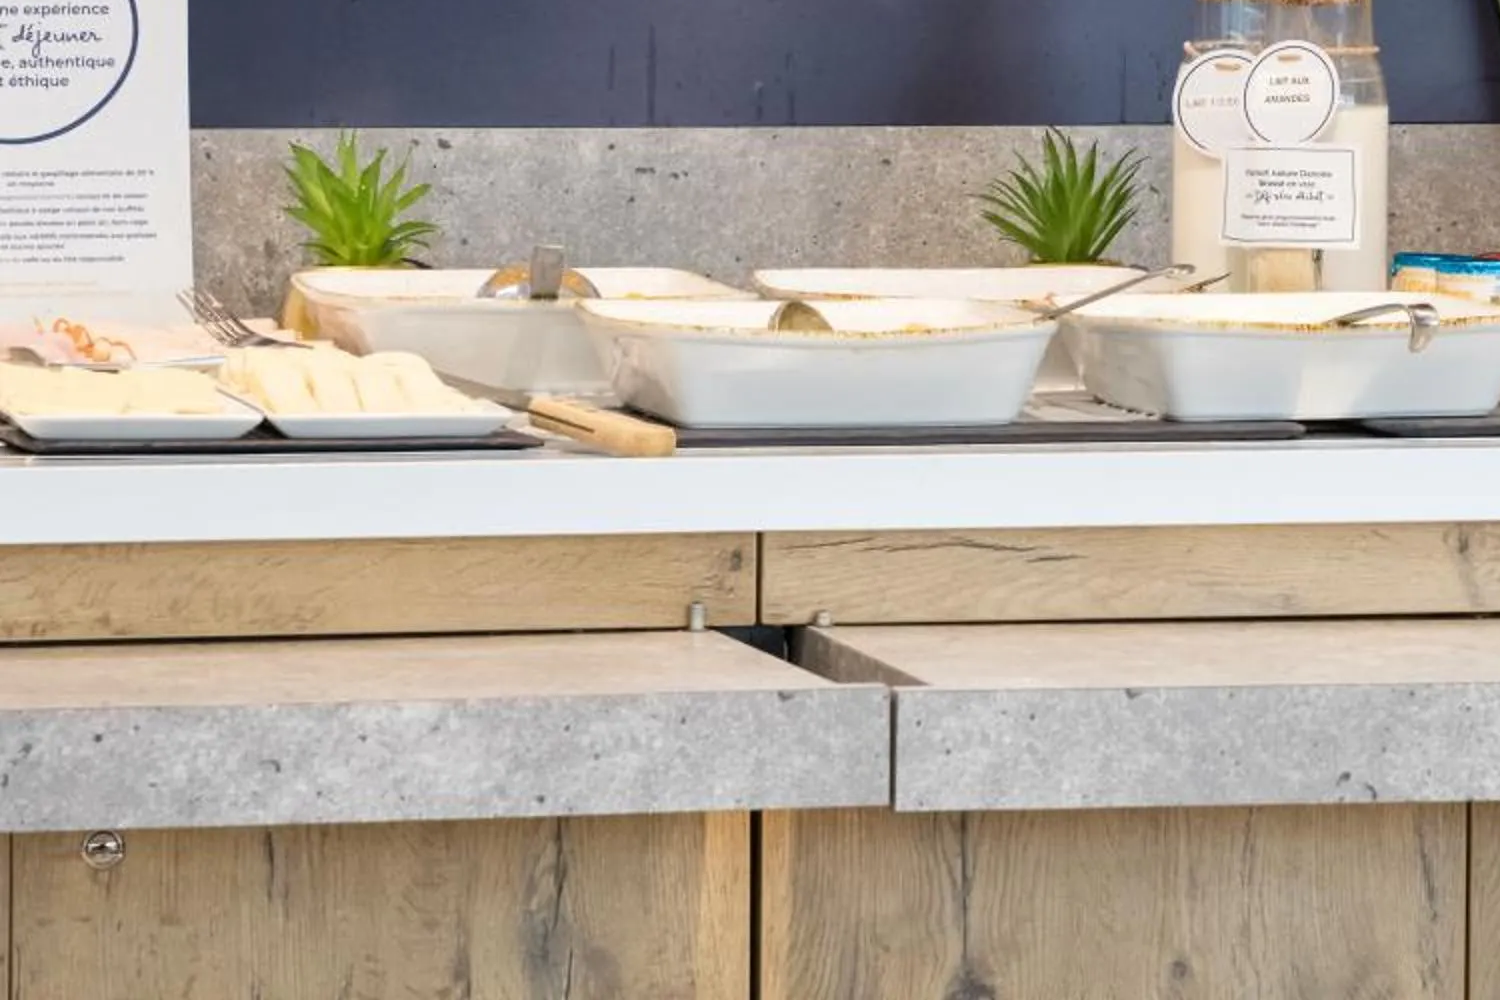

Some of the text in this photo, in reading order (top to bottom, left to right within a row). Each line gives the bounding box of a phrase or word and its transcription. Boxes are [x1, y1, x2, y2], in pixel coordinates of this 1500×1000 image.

[12, 22, 103, 59] déjeuner
[19, 56, 116, 70] authentique
[8, 74, 70, 89] éthique
